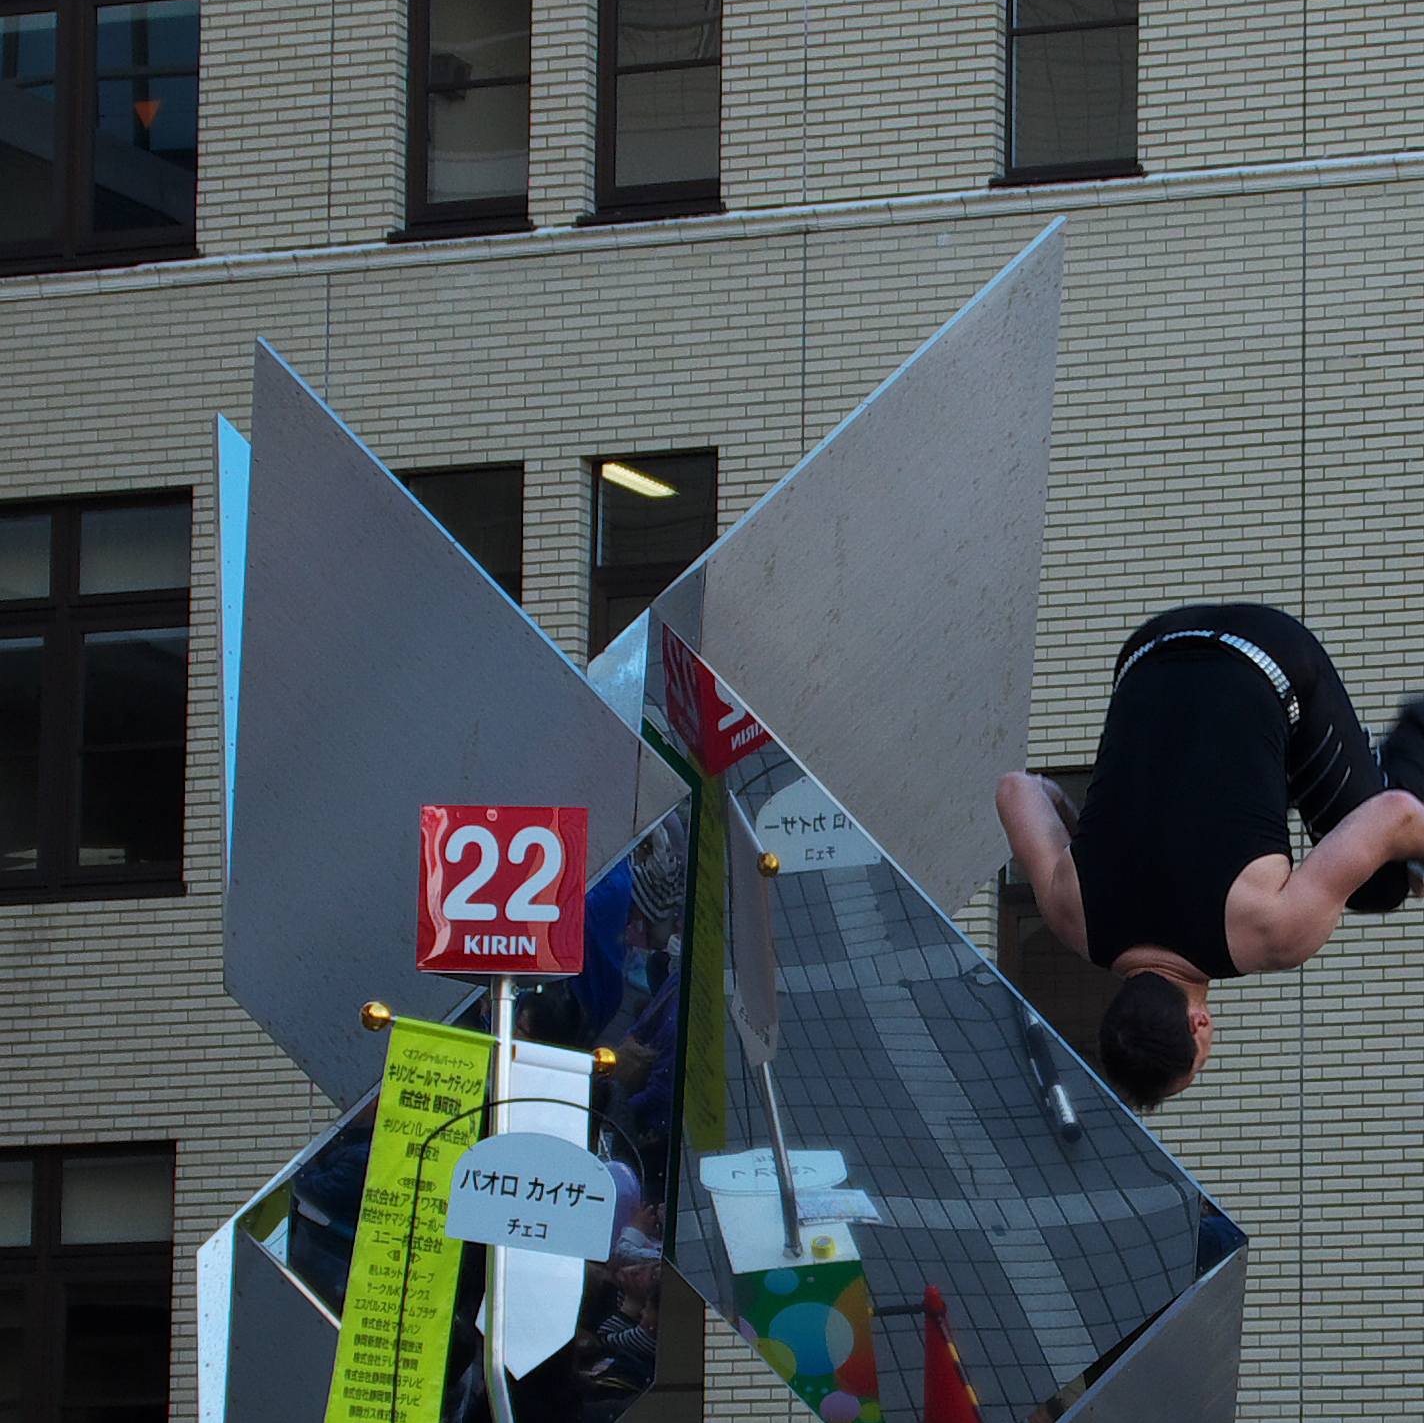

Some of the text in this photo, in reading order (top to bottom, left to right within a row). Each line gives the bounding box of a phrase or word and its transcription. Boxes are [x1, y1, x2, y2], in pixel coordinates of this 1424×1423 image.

[443, 825, 562, 922] 22
[464, 935, 537, 956] KIRIN
[388, 1062, 483, 1096] キリンビールマーケティング
[460, 1168, 605, 1208] パオロ カイザー
[507, 1217, 548, 1240] チェコ
